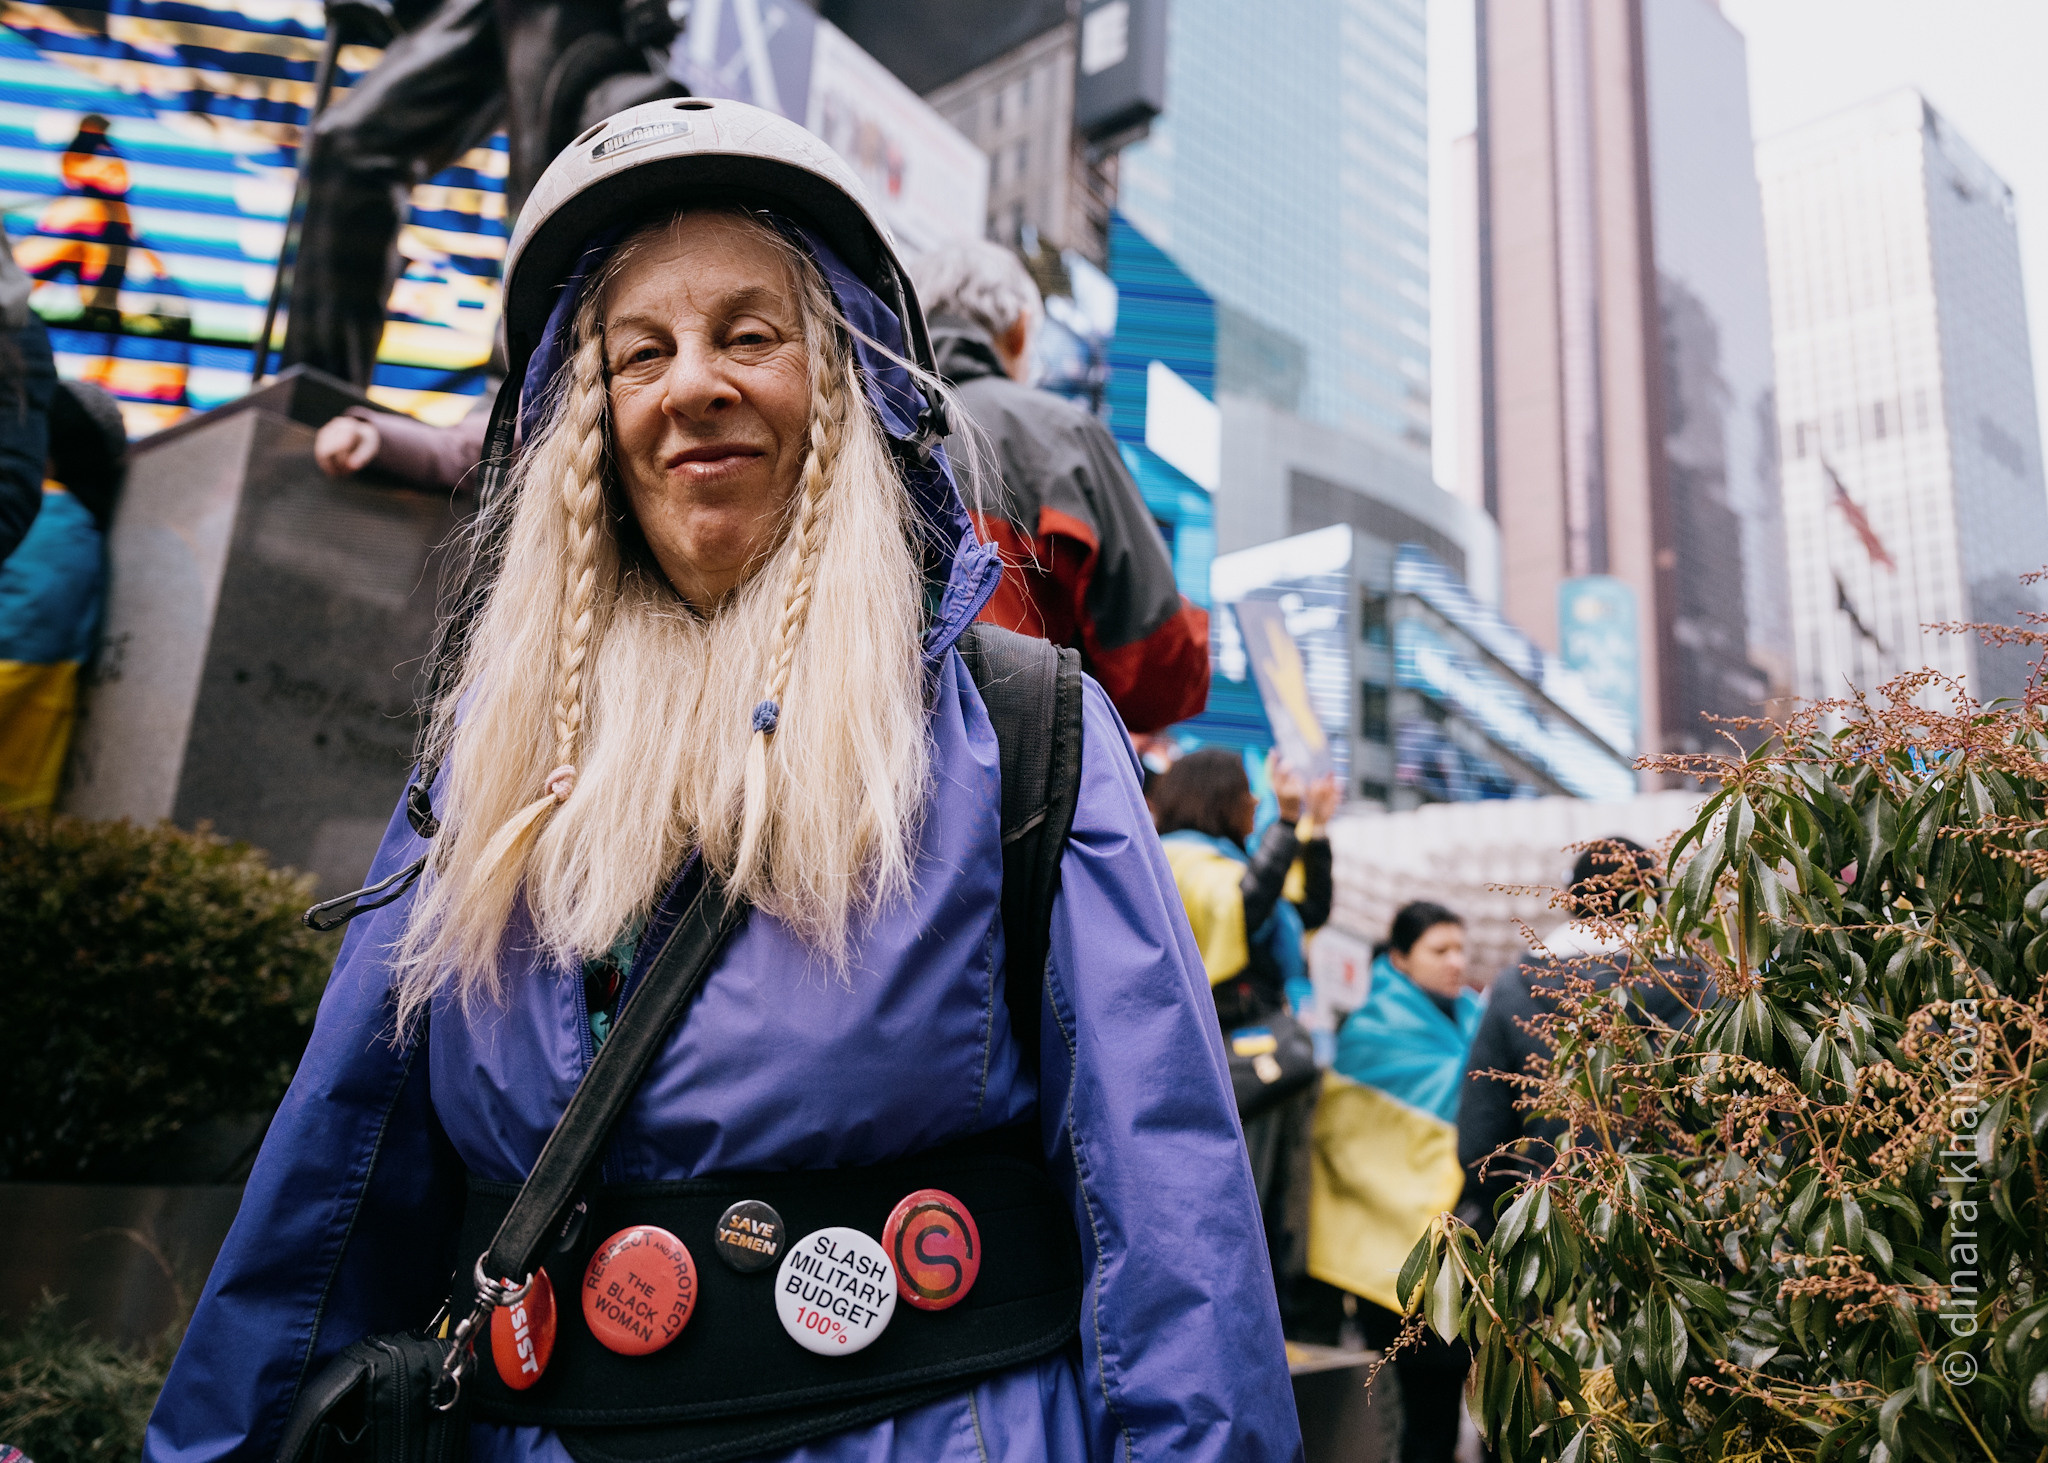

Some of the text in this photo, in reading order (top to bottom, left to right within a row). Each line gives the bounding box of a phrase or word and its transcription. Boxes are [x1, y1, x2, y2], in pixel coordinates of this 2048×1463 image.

[719, 1227, 777, 1255] YEMEN
[729, 1214, 776, 1238] SAVE
[789, 1251, 891, 1308] MILITARY
[814, 1236, 887, 1282] SLASH
[586, 1232, 692, 1339] RESPECT AND PROTECT
[607, 1282, 658, 1325] BLACK
[628, 1272, 656, 1299] THE
[785, 1274, 879, 1329] BUDGET
[595, 1295, 654, 1343] WOMAN
[796, 1306, 848, 1344] 100%
